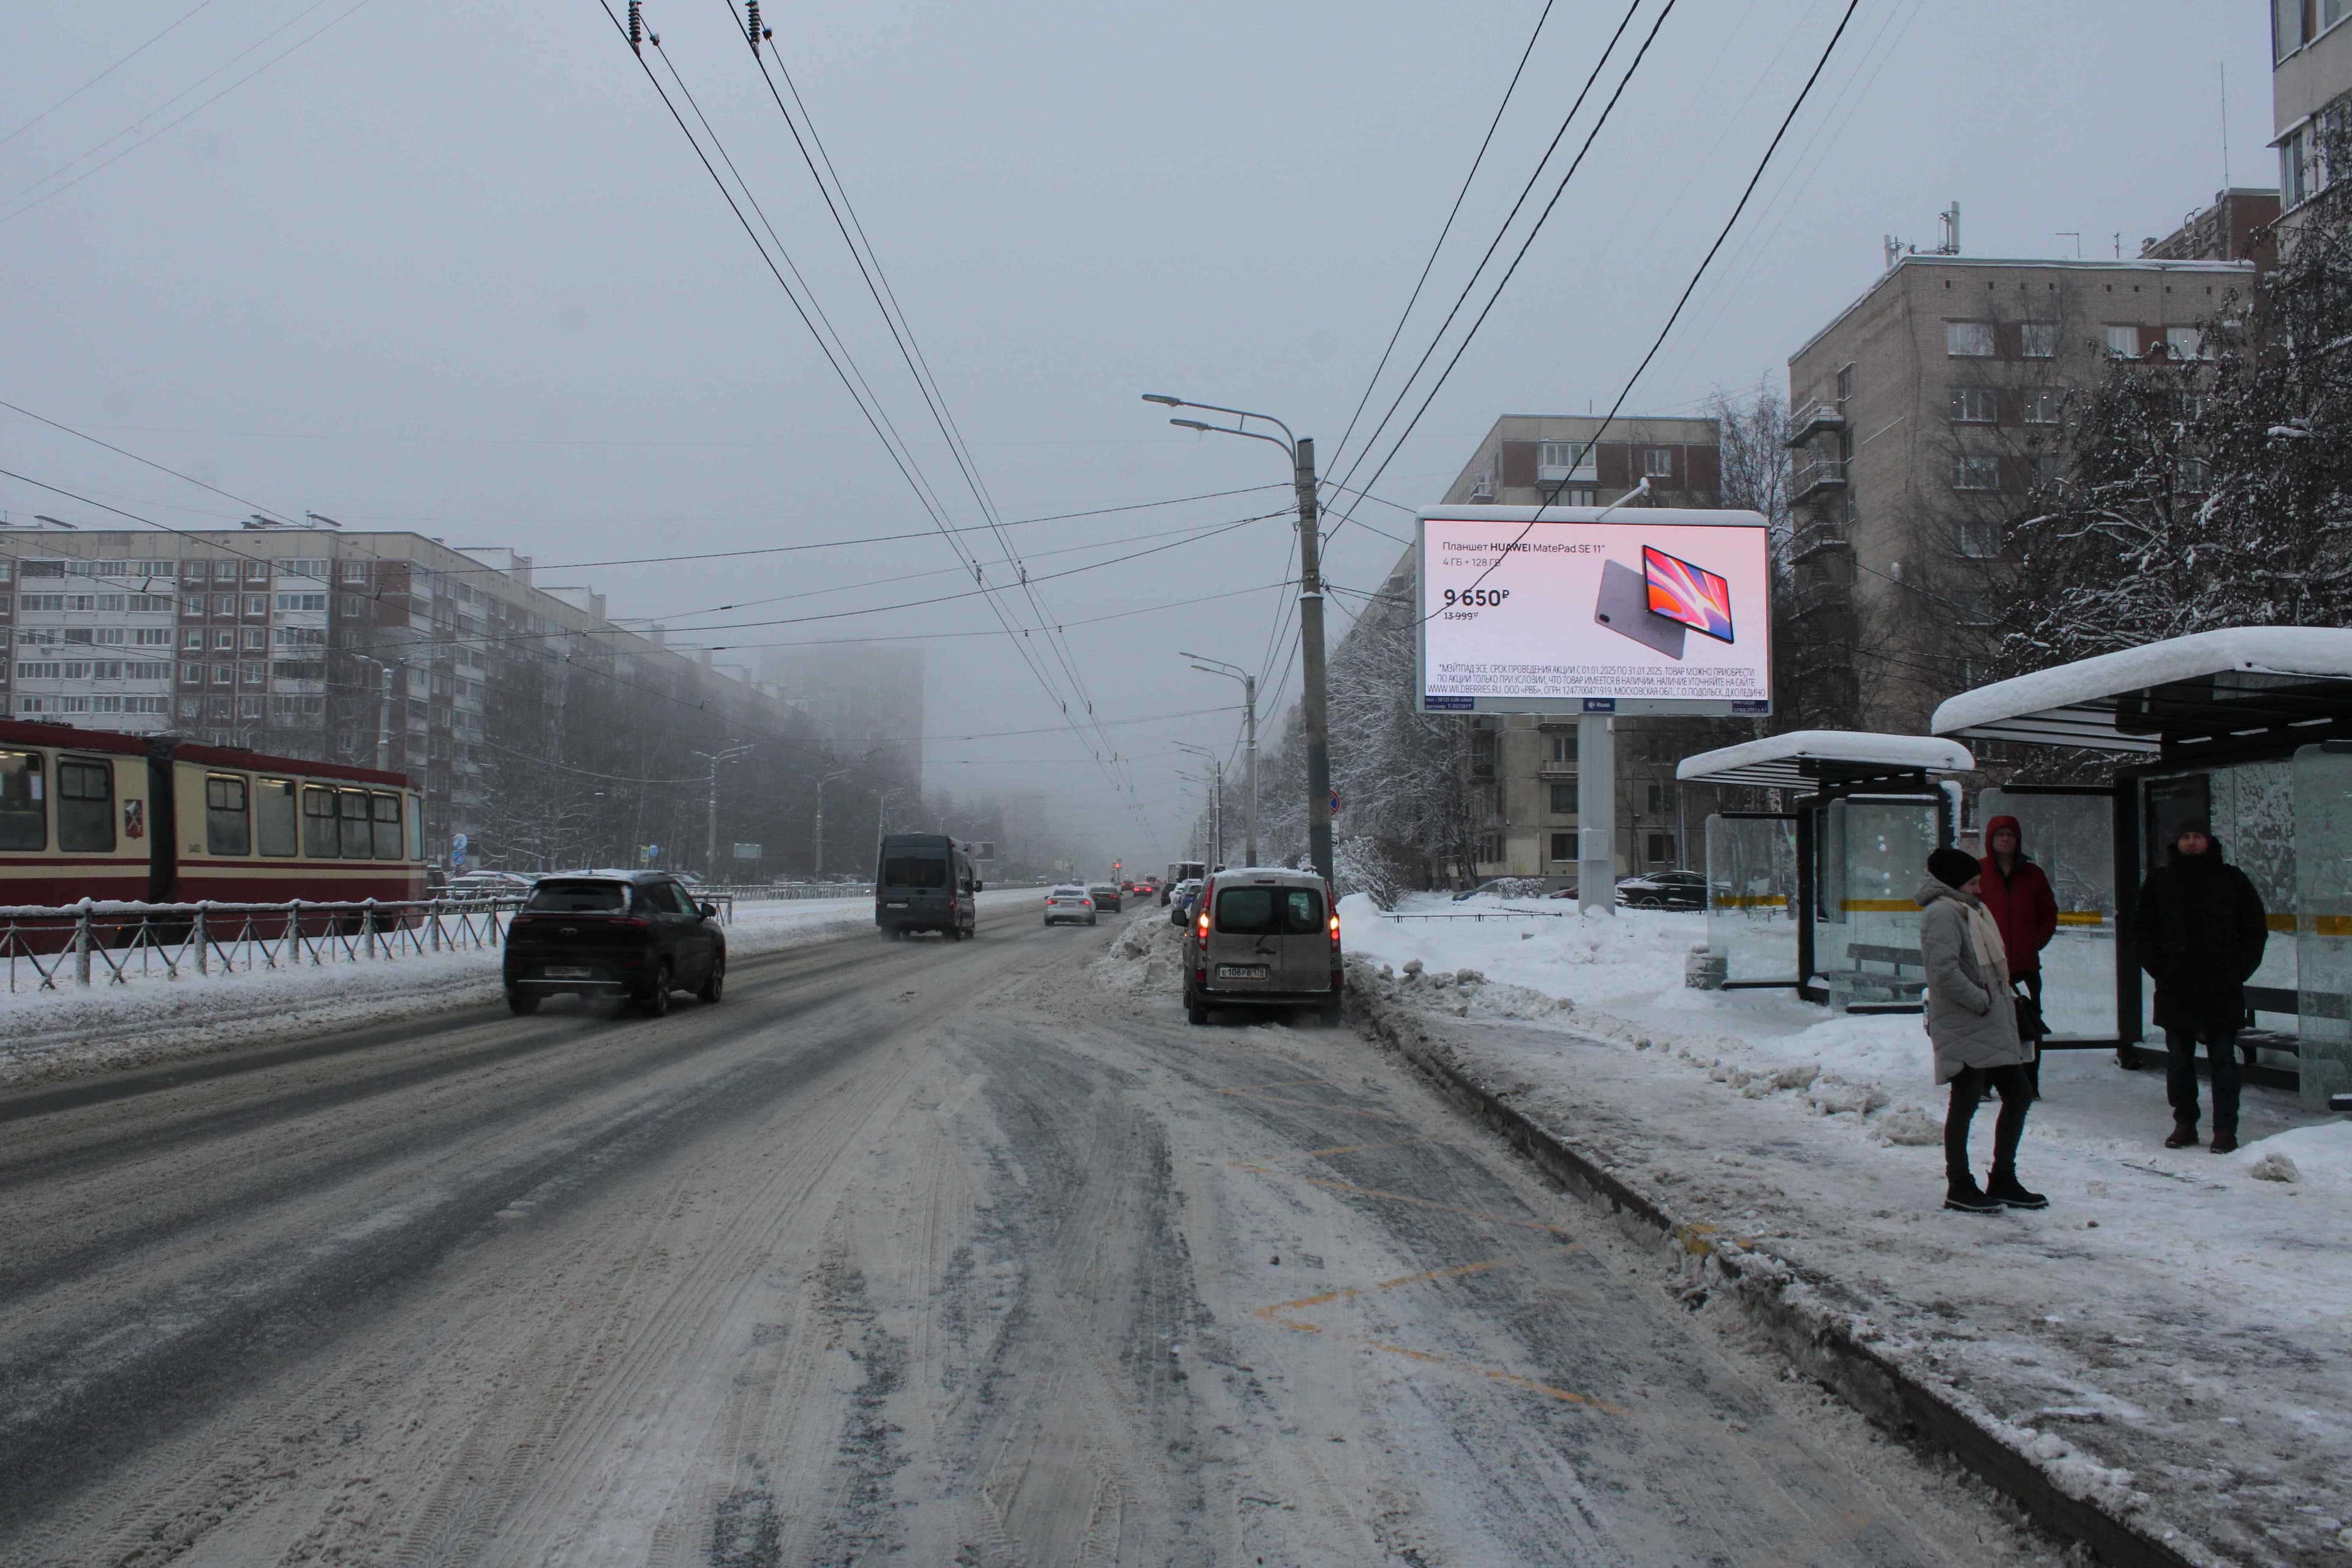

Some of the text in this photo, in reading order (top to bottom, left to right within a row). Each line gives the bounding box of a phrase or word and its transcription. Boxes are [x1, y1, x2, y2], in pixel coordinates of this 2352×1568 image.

[1443, 542, 1488, 551] Планшет
[1509, 665, 1551, 675] ПРОВЕДЕНИЯ
[1553, 666, 1575, 676] АКЦИИ
[1582, 666, 1616, 674] 01.01.2025
[1686, 667, 1712, 676] МОЖНО
[1438, 674, 1447, 683] ПО
[1449, 674, 1470, 685] АКЦИИ
[1473, 675, 1498, 684] ТОЛЬКО
[1500, 675, 1513, 684] ПРИ
[1515, 676, 1547, 685] УСЛОВИИ,
[1548, 676, 1561, 684] ЧТО
[1563, 676, 1583, 684] ТОВАР
[1585, 676, 1614, 685] ИМЕЕТСЯ
[1657, 677, 1687, 685] НАЛИЧИЕ
[1689, 676, 1724, 685] УТОЧНЯЙТЕ
[1726, 677, 1734, 686] НА
[1736, 676, 1754, 686] САЙТЕ
[1615, 687, 1657, 696] МОСКОВСКАЯ
